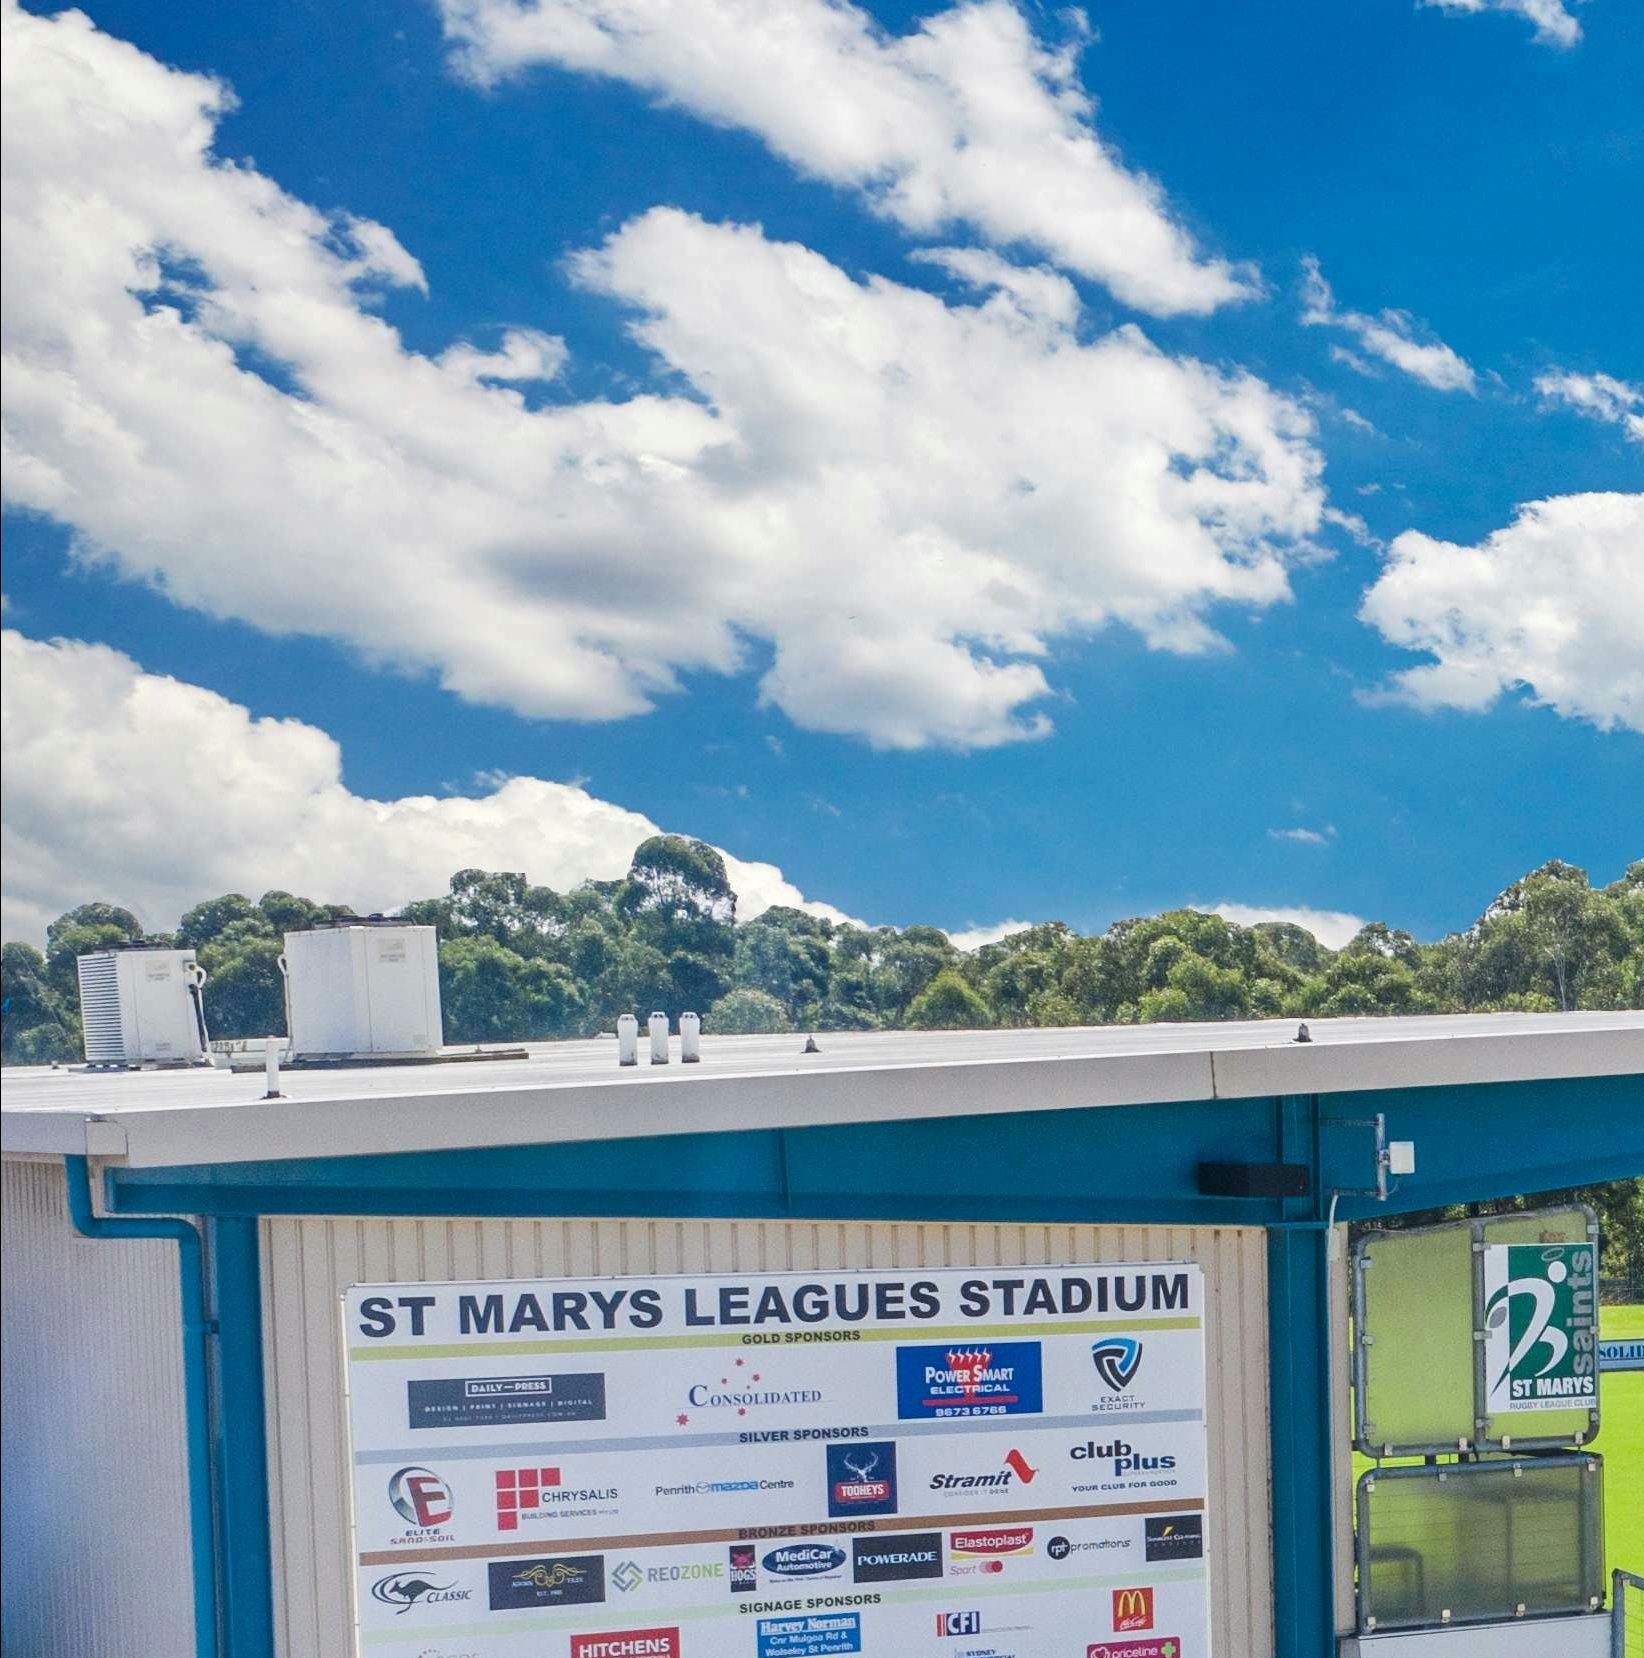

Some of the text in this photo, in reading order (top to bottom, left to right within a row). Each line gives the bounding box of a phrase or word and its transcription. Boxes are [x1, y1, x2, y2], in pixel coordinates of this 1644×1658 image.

[359, 1273, 1190, 1338] ST MARYS LEAGUES STADIUM
[1566, 1250, 1594, 1376] saints
[741, 1329, 862, 1346] GOLD SPONSORS
[925, 1364, 1014, 1384] POWER SMART
[470, 1381, 547, 1393] DAILY PRESS
[929, 1384, 1011, 1395] ELECTRICAL
[1512, 1375, 1594, 1398] ST MARYS
[688, 1384, 822, 1409] CONSOLIDATED
[1100, 1395, 1136, 1403] EXACT
[1540, 1400, 1572, 1409] LEAGUE
[1091, 1401, 1147, 1412] SECURITY
[739, 1426, 869, 1444] SILVER SPONSORS
[1070, 1440, 1132, 1460] club
[1114, 1454, 1176, 1477] plus
[655, 1484, 695, 1496] Penrith
[759, 1479, 794, 1490] Centre
[929, 1471, 1012, 1490] Stramit
[1072, 1479, 1178, 1493] YOUR CLUB FOR GOOD
[541, 1488, 619, 1504] CHRYSALIS
[840, 1484, 885, 1497] TOOHEYS
[405, 1528, 441, 1537] ELITE
[739, 1520, 876, 1540] BRONZE SPONSORS
[954, 1533, 1027, 1549] Elastoplast
[776, 1548, 832, 1563] MediCar
[857, 1551, 938, 1566] POWERADE
[648, 1563, 724, 1584] REOZONE
[776, 1561, 833, 1573] Automotive
[950, 1564, 977, 1576] Sport
[427, 1588, 473, 1604] CLASSIC
[739, 1594, 882, 1614] SIGNAGE SPONSORS
[760, 1616, 856, 1636] Harvey Norman
[579, 1637, 671, 1658] HITCHENS
